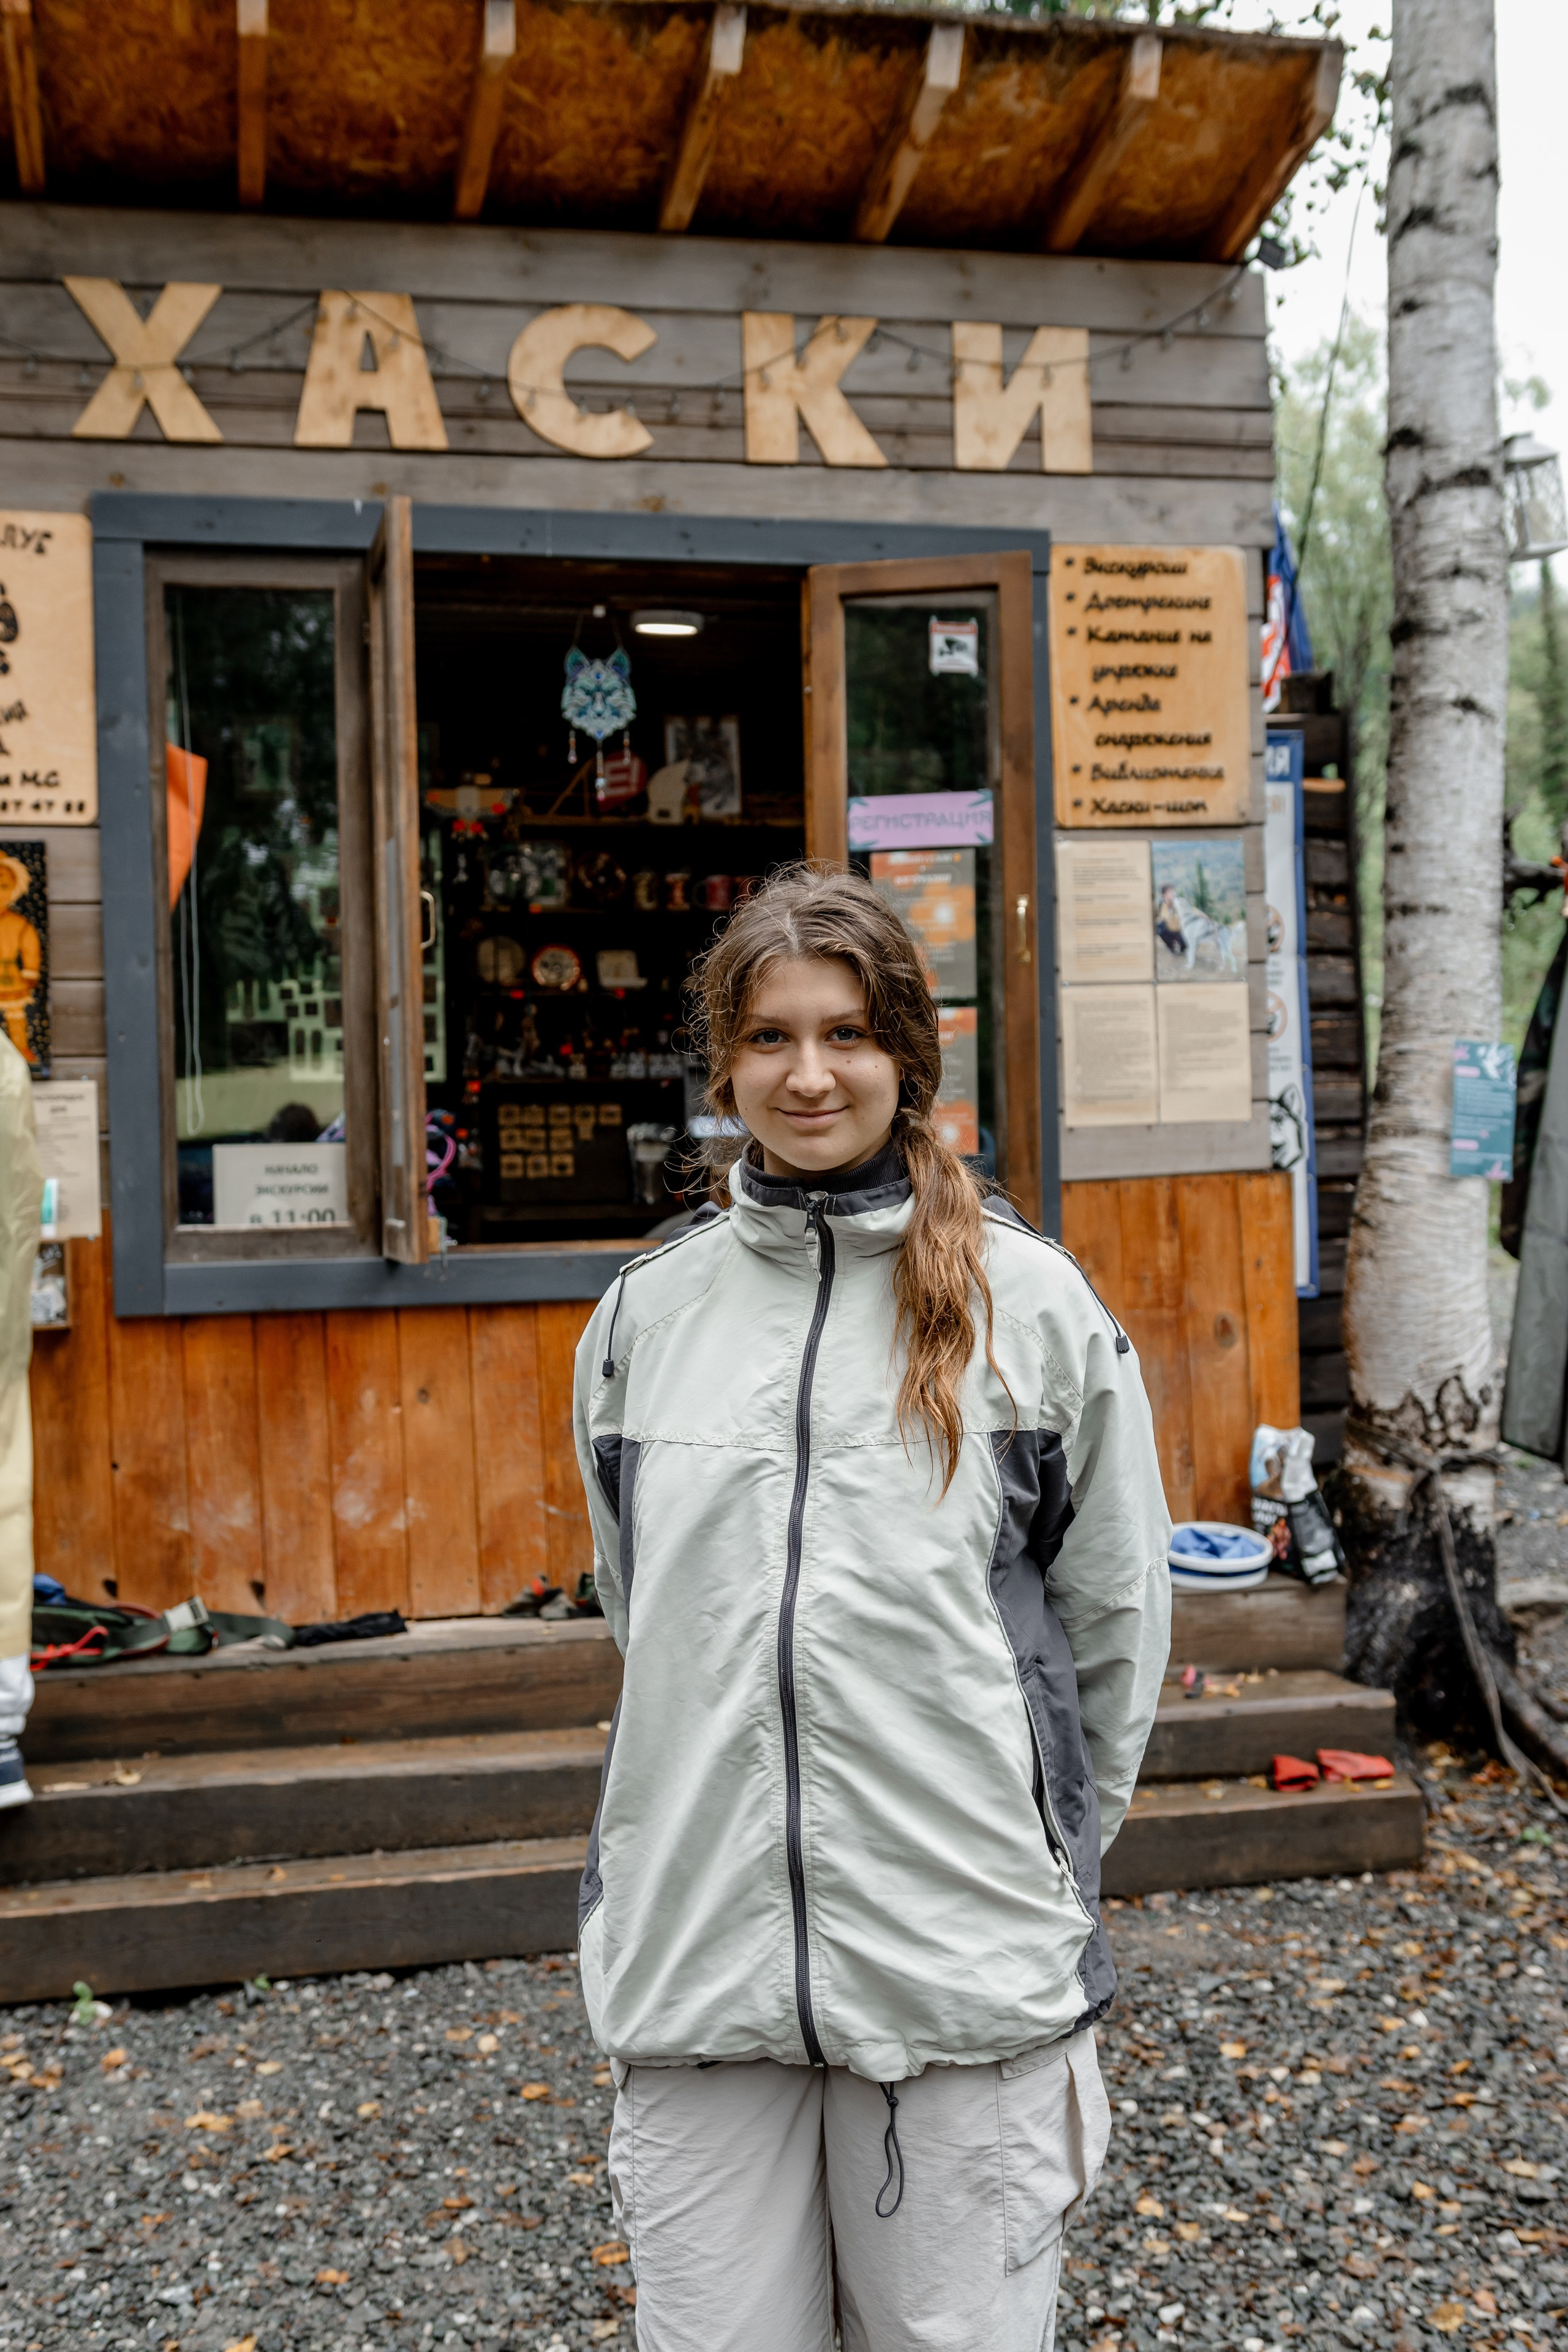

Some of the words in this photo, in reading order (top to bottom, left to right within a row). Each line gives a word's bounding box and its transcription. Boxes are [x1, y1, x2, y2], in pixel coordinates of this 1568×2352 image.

[62, 276, 1093, 472] ХАСКИ
[1084, 557, 1187, 578] Экскурсии
[1088, 625, 1180, 643] Катание
[1190, 630, 1212, 643] на
[1088, 693, 1160, 716] Аренда
[851, 811, 993, 830] РЕГИСТРАЦИЯ
[265, 1164, 318, 1175] НАЧАЛО
[256, 1185, 329, 1194] ЭКСКУРСИИ
